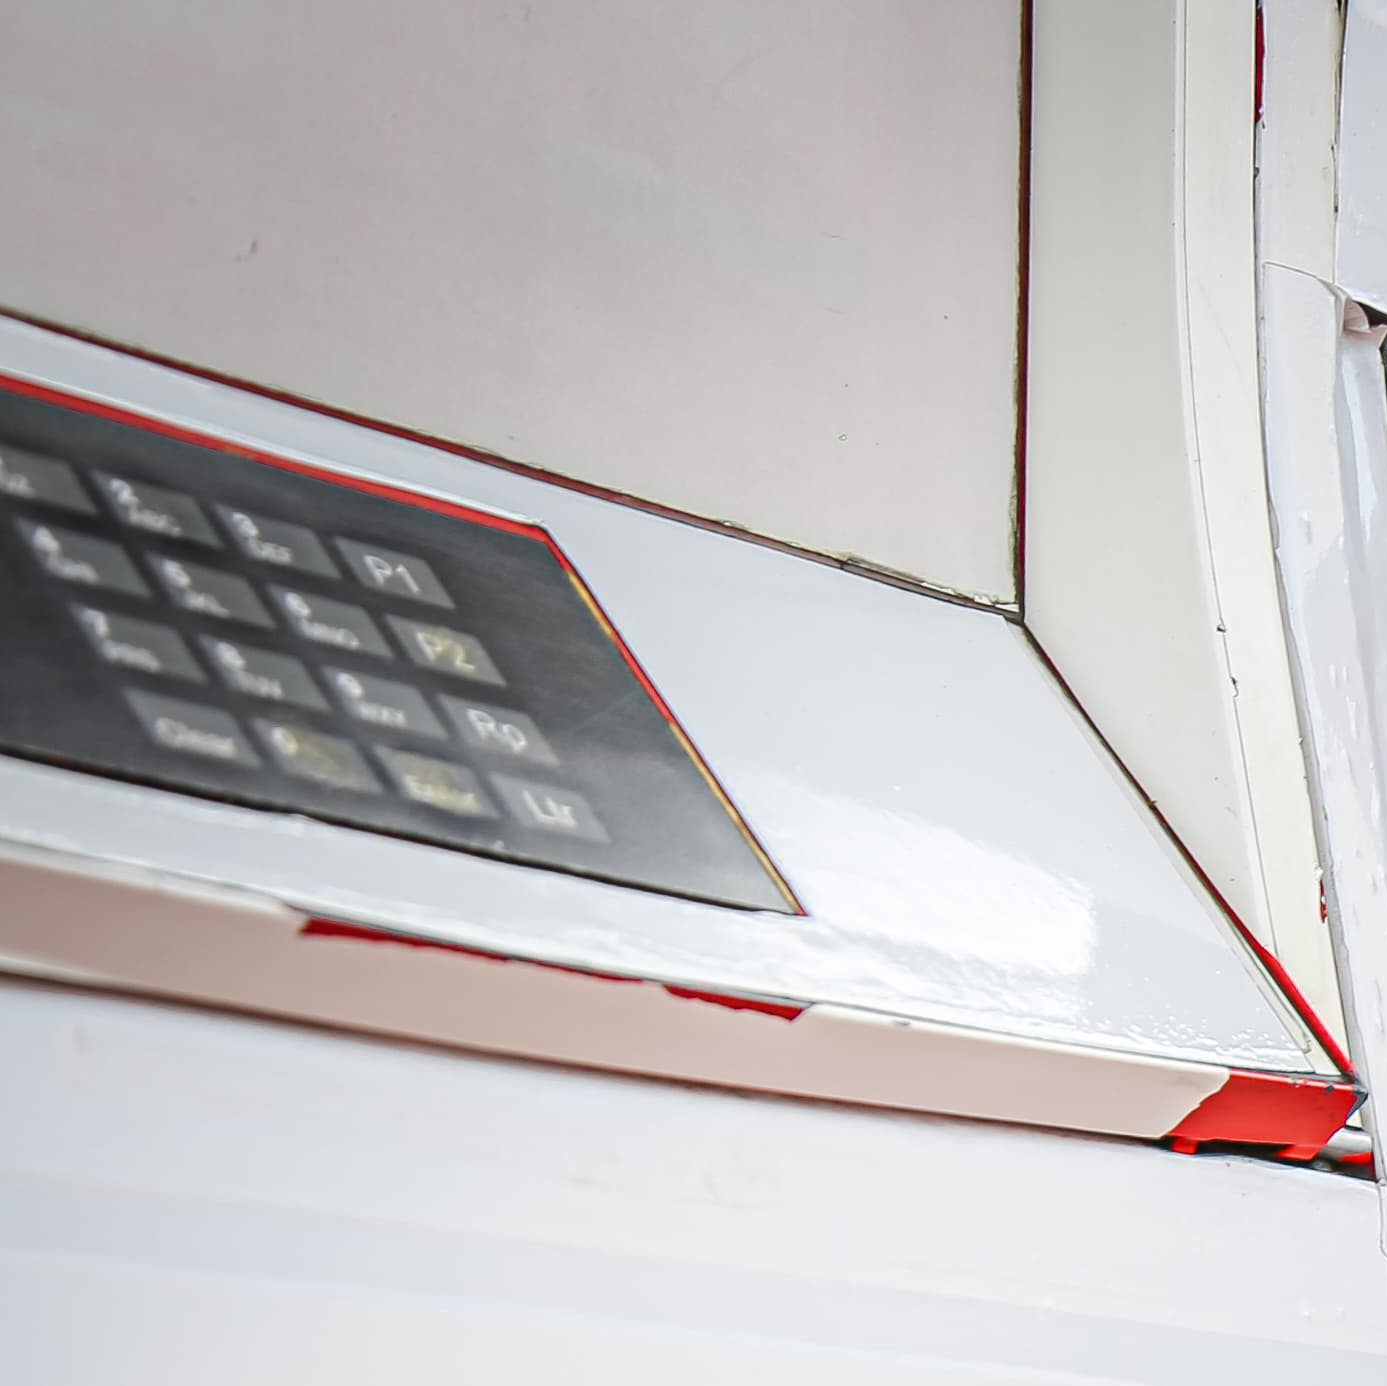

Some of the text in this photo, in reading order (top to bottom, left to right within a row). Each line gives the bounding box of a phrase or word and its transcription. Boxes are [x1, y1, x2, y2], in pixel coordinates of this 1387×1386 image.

[110, 477, 138, 504] 2
[33, 525, 61, 551] 4
[232, 512, 259, 538] 3
[363, 554, 420, 593] P1
[284, 592, 311, 617] 6
[416, 630, 475, 670] P2
[336, 670, 364, 698] 9
[155, 717, 236, 761] Clear
[466, 707, 527, 754] Rp
[521, 789, 577, 830] Ltr
